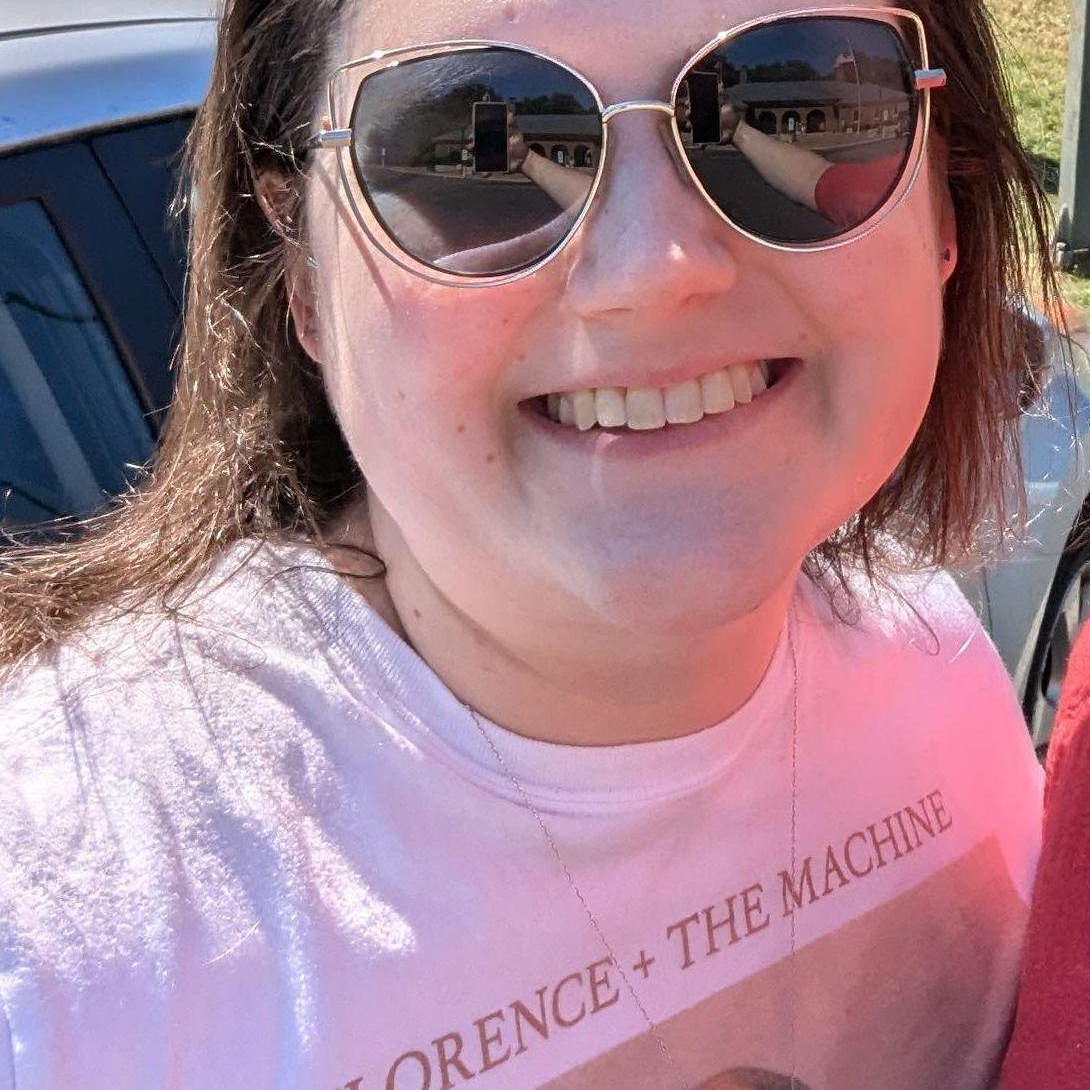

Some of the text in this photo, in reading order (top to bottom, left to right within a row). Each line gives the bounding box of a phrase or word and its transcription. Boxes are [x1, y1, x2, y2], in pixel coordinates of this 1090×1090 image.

[334, 956, 621, 1090] ORENCE
[666, 883, 770, 970] THE
[777, 790, 953, 918] MACHINE
